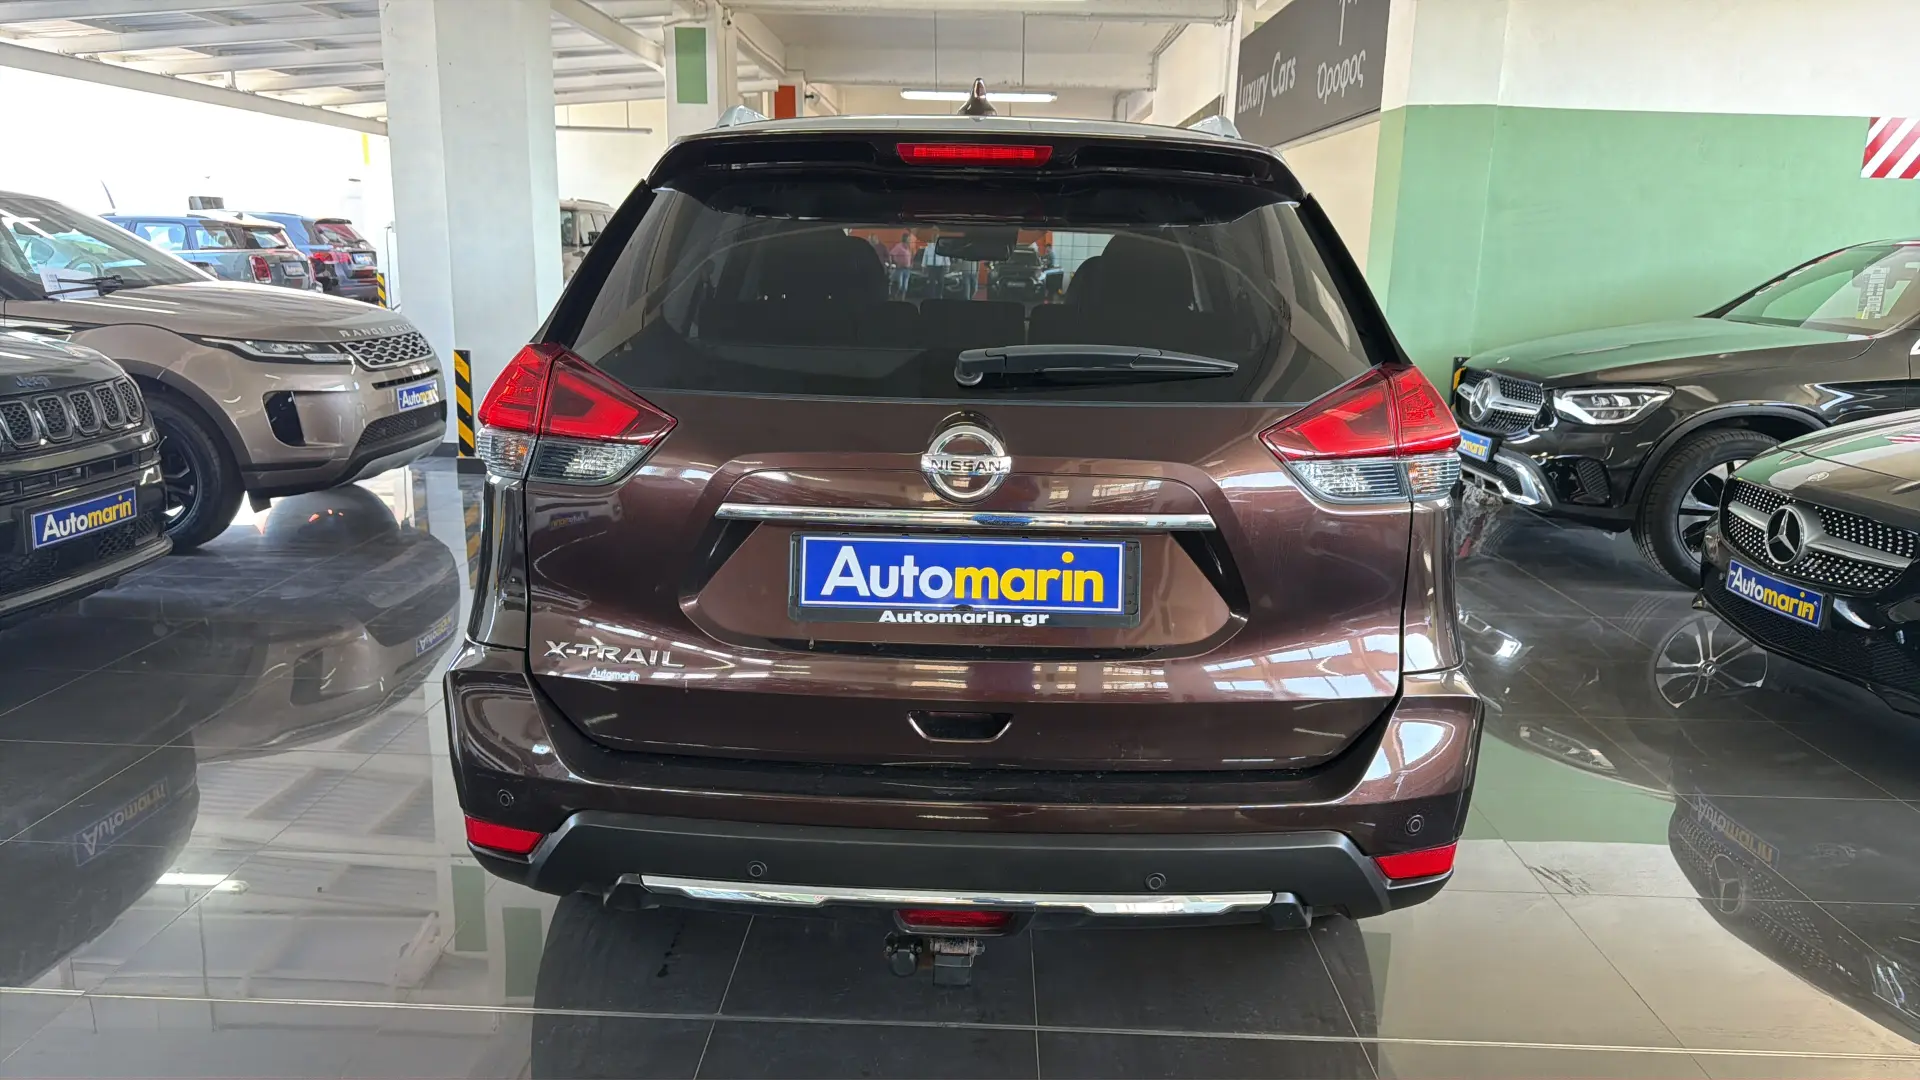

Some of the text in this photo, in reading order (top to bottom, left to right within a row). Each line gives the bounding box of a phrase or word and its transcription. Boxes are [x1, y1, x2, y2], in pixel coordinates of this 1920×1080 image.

[1238, 51, 1296, 117] Luxury Cars
[338, 327, 387, 338] RANGE
[931, 459, 1001, 472] NISSAN
[42, 495, 132, 542] Automarin
[820, 545, 1104, 603] Automarin
[1731, 566, 1815, 621] Automarin
[879, 610, 1050, 627] Automarin.gr
[544, 636, 685, 668] X-TRAIL
